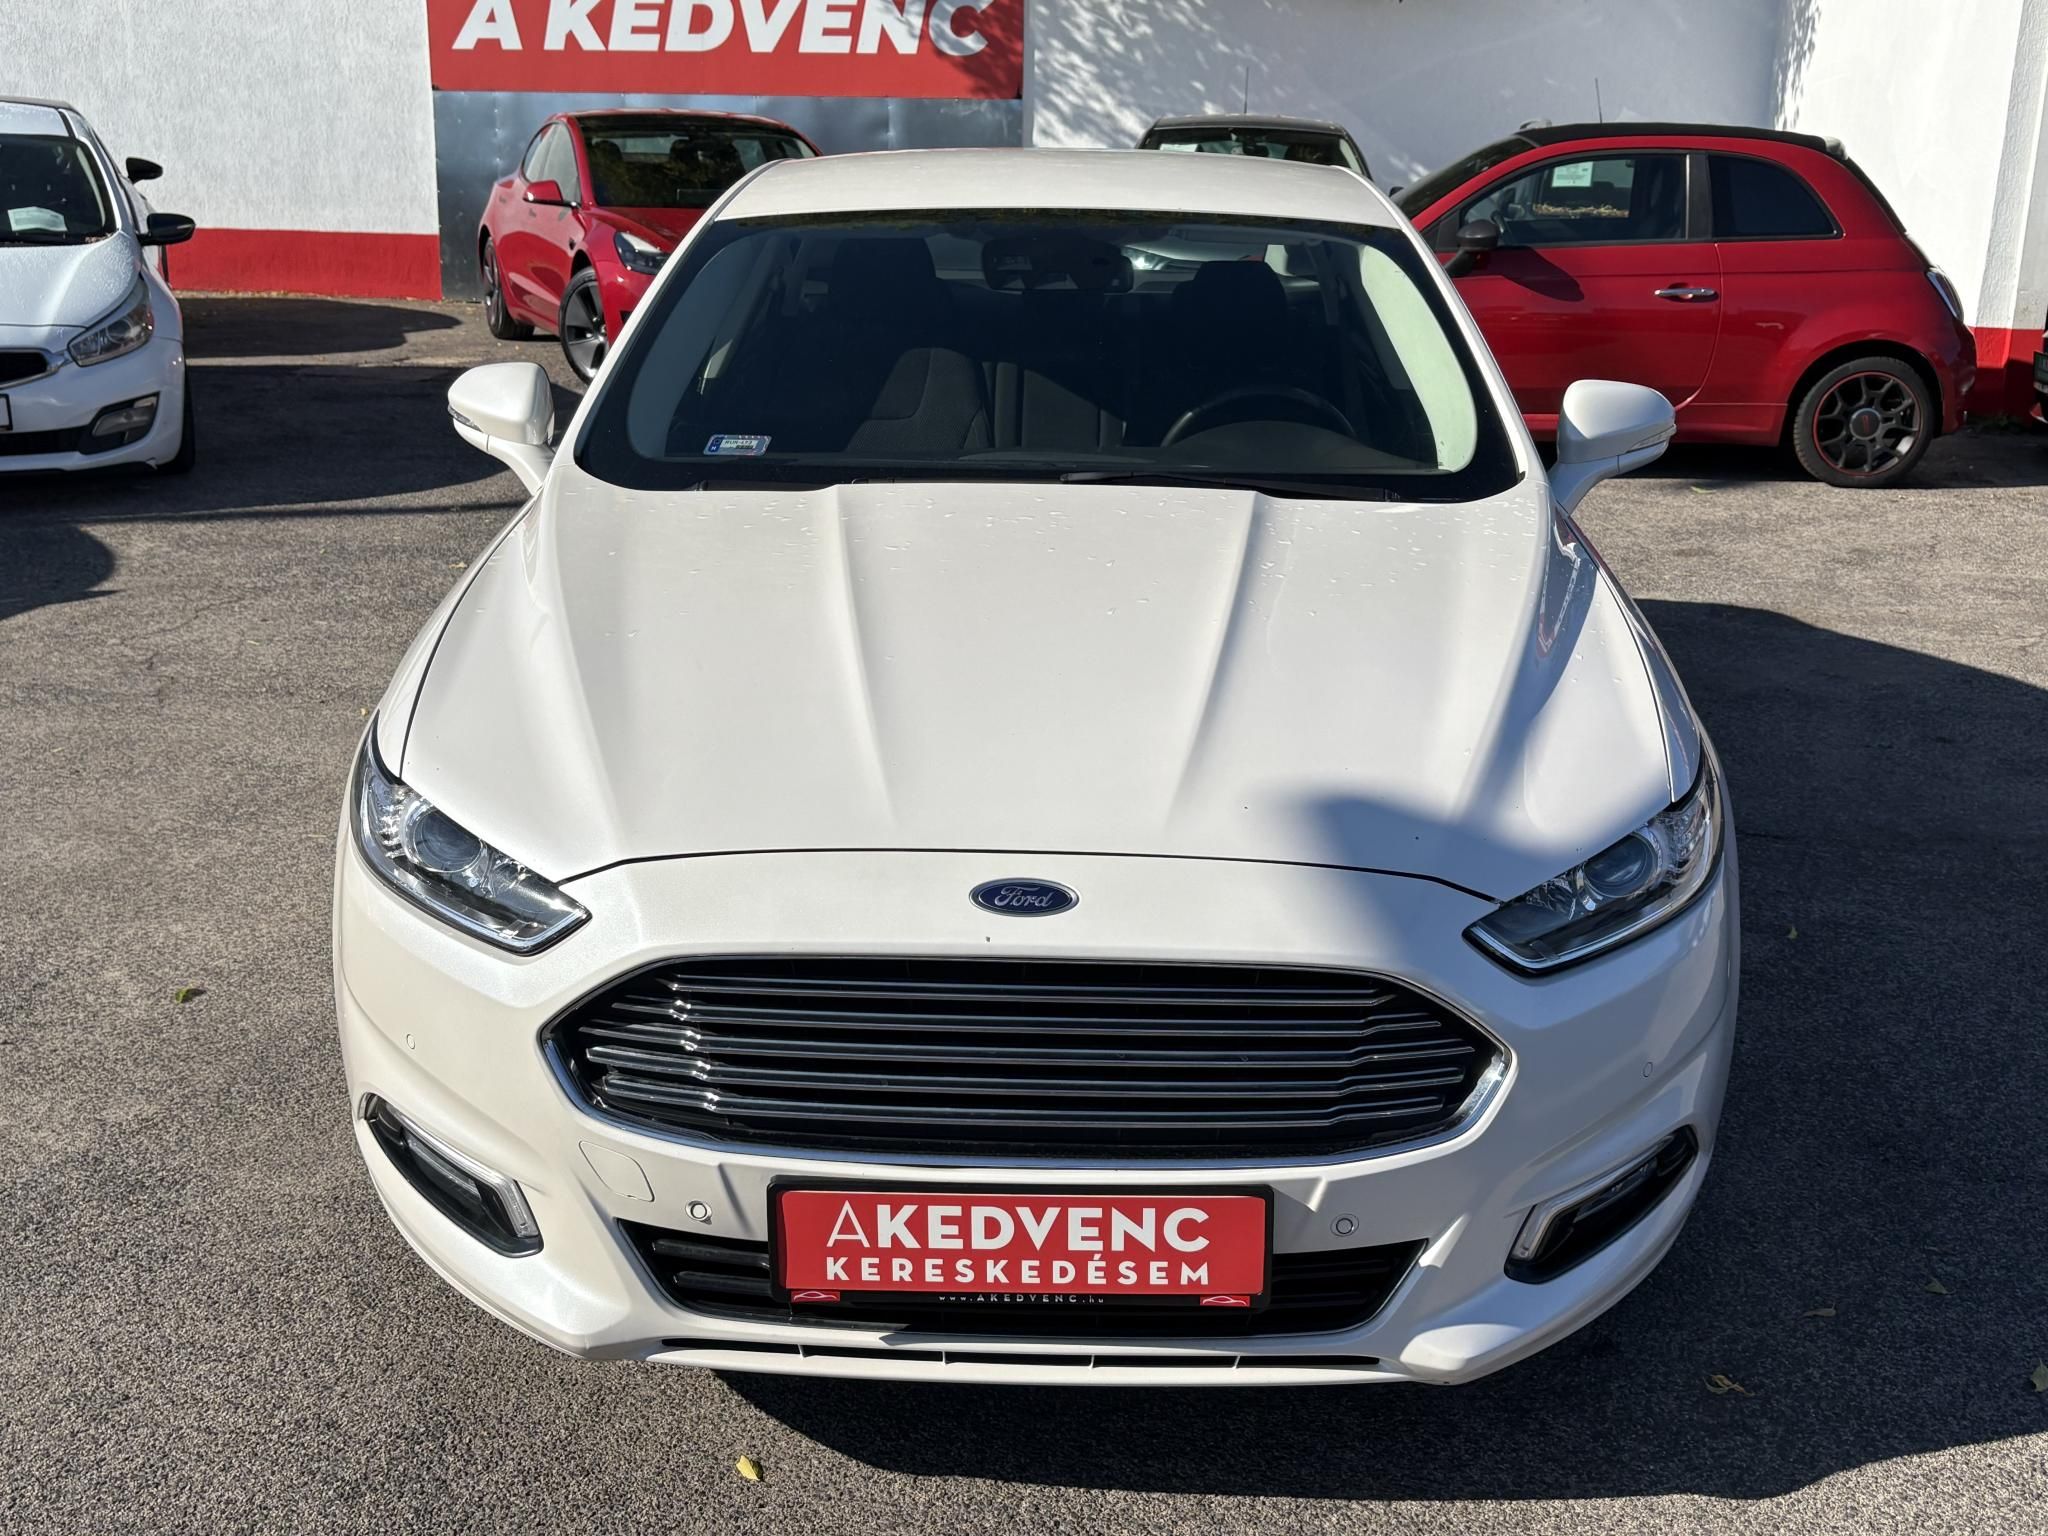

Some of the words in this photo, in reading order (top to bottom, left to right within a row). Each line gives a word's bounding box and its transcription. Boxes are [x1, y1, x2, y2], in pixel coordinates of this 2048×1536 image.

[451, 0, 523, 50] A
[543, 0, 993, 56] KEDVENC
[994, 886, 1054, 907] Ford
[826, 1253, 1209, 1285] KERESKEDÉSEM
[938, 1293, 1104, 1304] www.AKEDVENC.hu
